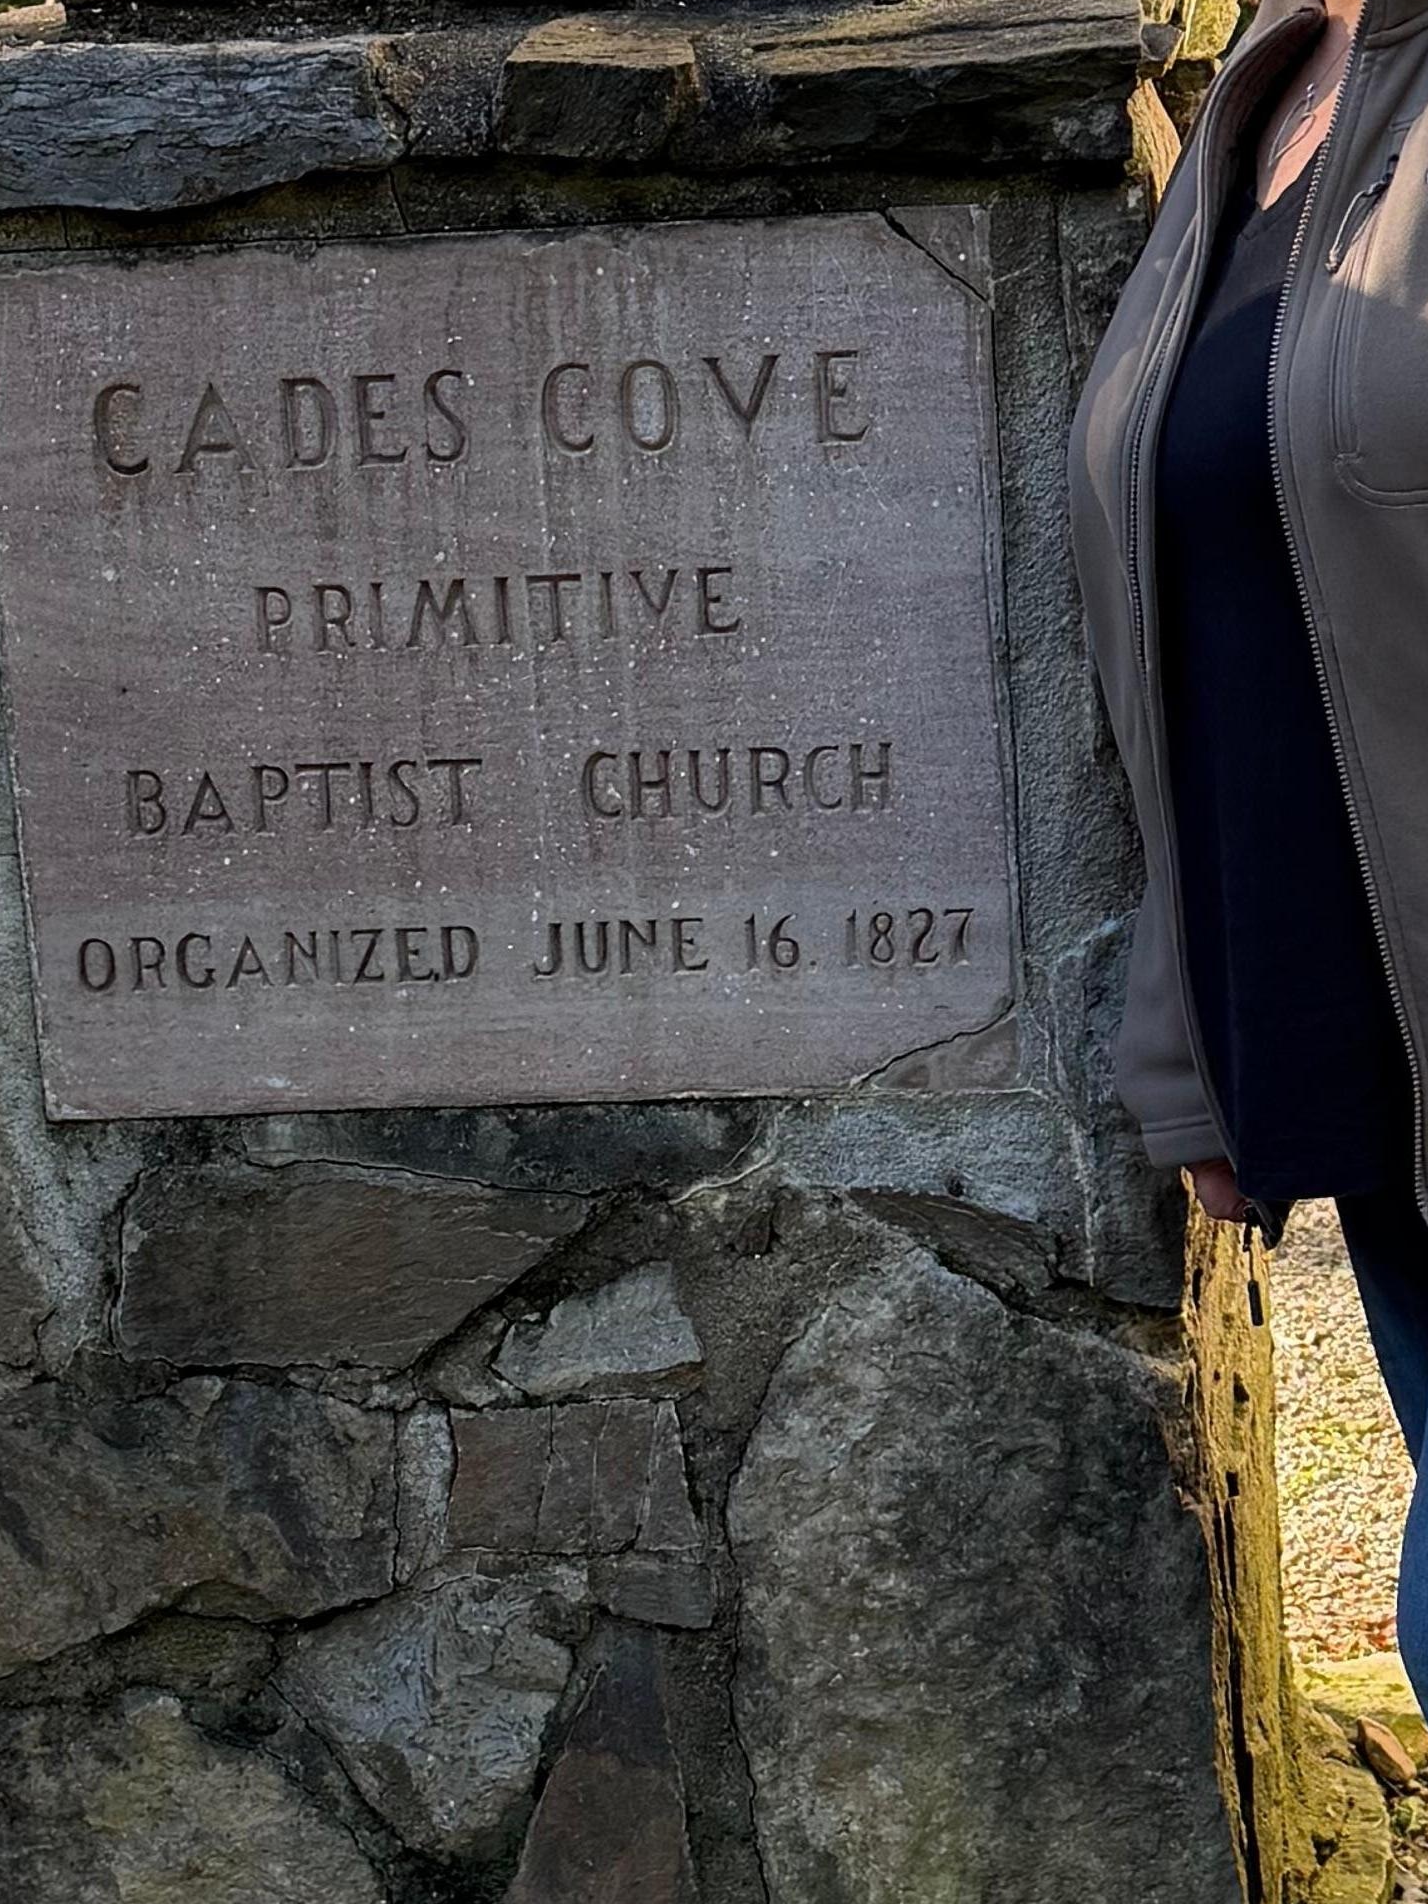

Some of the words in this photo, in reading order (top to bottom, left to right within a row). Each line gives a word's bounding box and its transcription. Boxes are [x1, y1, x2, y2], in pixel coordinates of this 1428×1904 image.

[92, 366, 470, 479] CADES
[541, 349, 874, 454] COVE
[253, 567, 743, 656] PRIMITIVE
[125, 758, 483, 838] BAPTIST
[580, 743, 894, 822] CHURCH
[78, 925, 480, 992] ORGANIZED
[533, 917, 709, 977] JUNE
[846, 907, 974, 968] 1827
